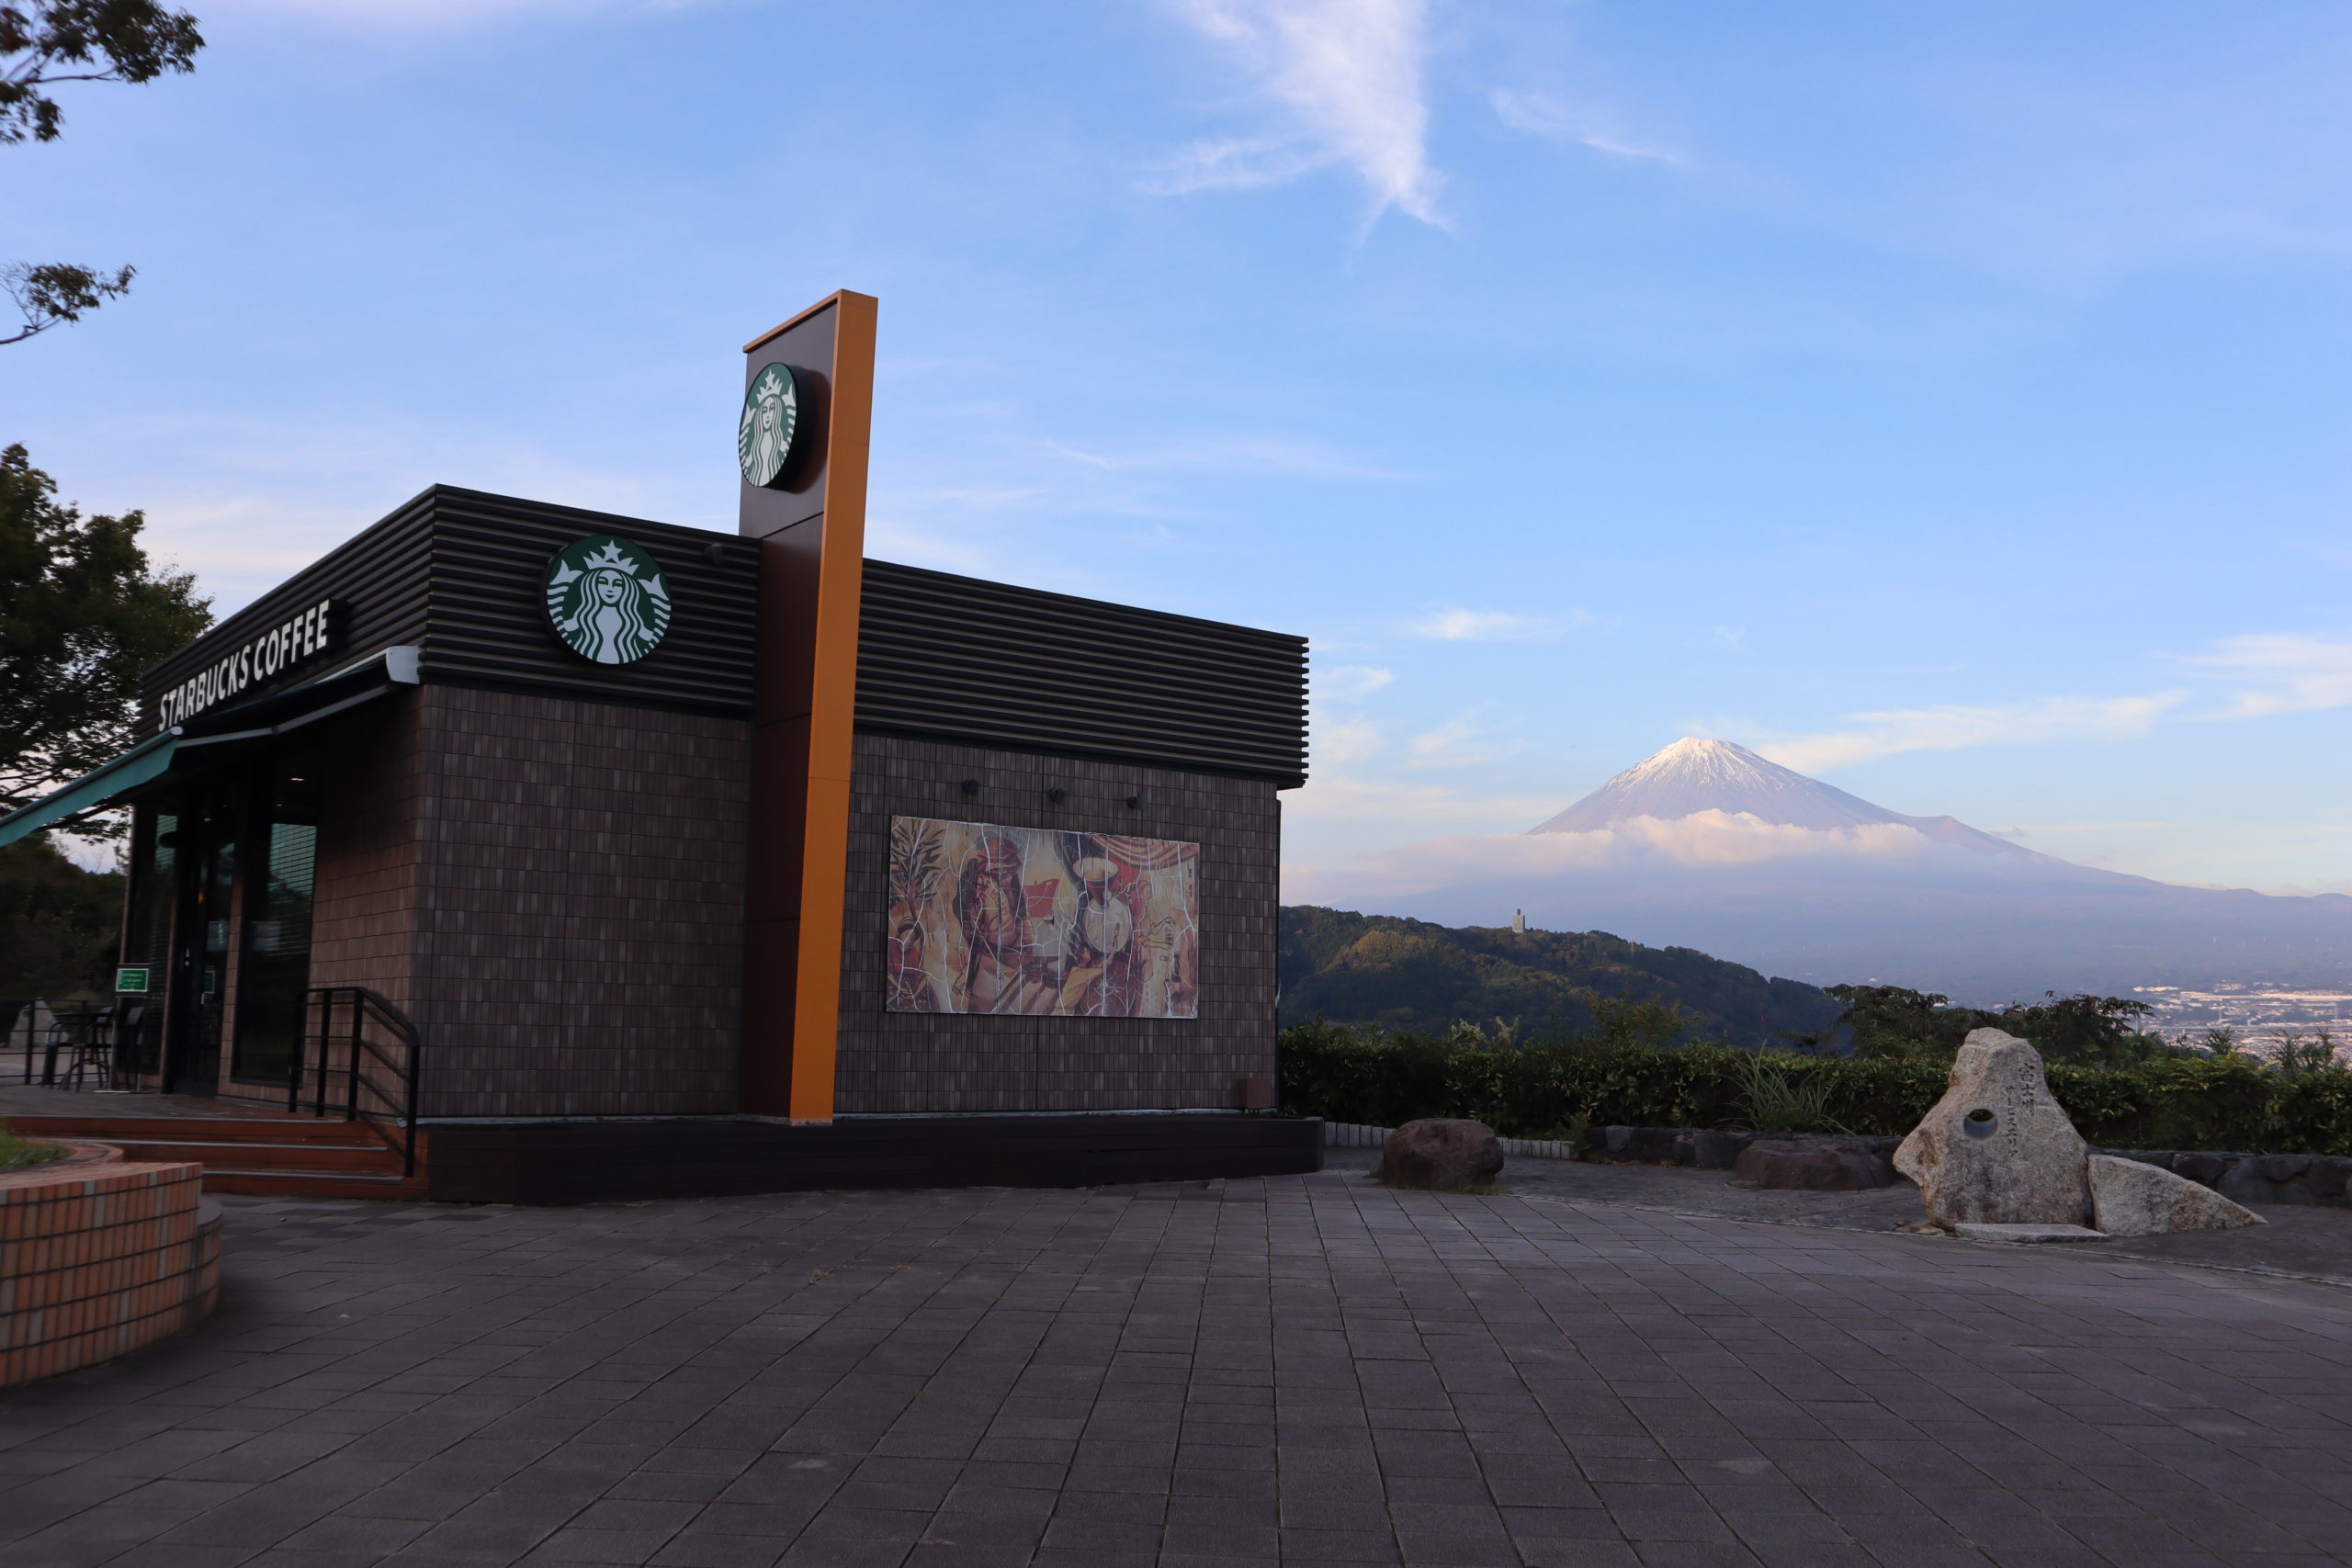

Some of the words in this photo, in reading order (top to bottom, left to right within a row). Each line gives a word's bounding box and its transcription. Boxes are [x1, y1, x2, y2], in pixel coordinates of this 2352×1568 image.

[158, 645, 251, 732] STARBUCKS
[254, 599, 330, 682] COFFEE
[2006, 1085, 2018, 1157] サービスエリア
[2018, 1062, 2035, 1117] 富士川
